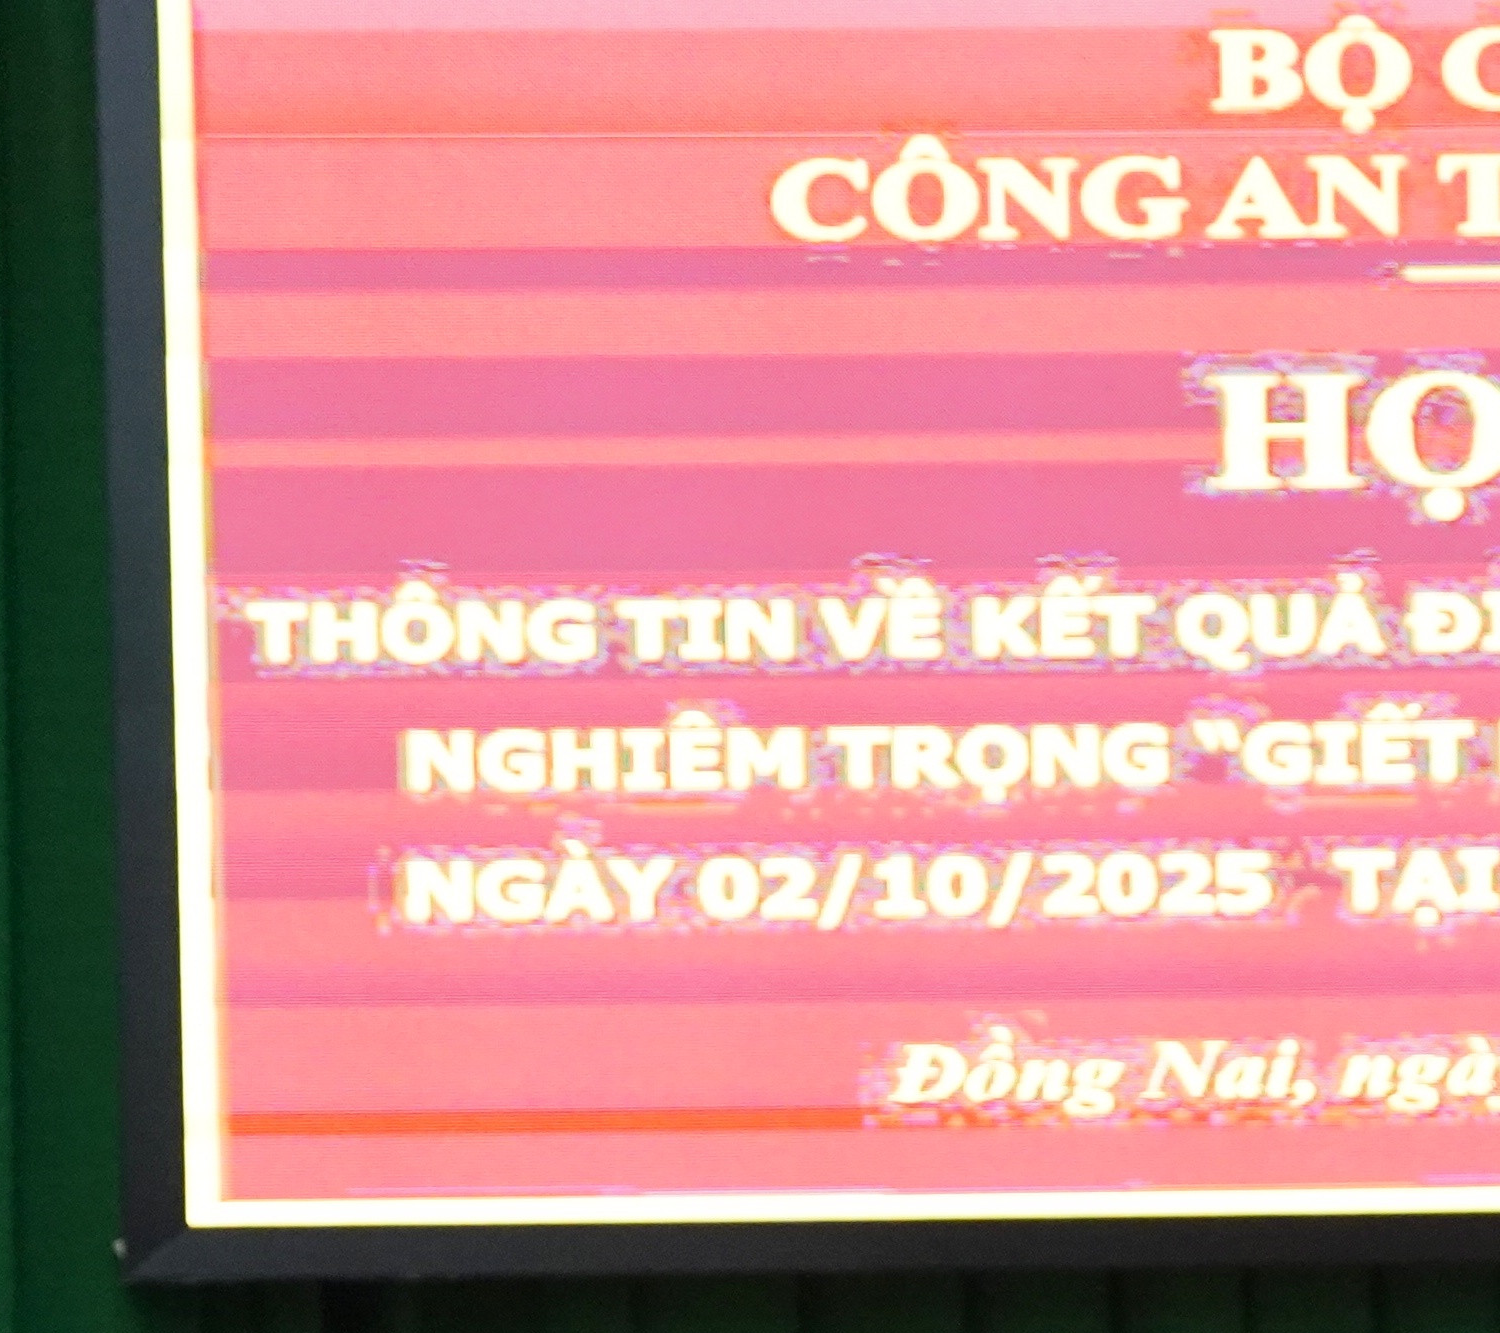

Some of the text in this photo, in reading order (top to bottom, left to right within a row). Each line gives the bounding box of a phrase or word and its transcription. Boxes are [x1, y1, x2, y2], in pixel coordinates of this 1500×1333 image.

[1212, 13, 1411, 130] BỘ
[772, 135, 1186, 240] CÔNG
[1209, 155, 1402, 238] AN
[244, 579, 597, 665] THÔNG
[617, 596, 795, 661] TIN
[819, 575, 942, 660] VỀ
[972, 573, 1156, 659] KẾT
[1175, 570, 1385, 673] QUẢ
[407, 708, 804, 794] NGHIÊM
[827, 721, 1170, 807] TRỌNG
[404, 837, 675, 924] NGÀY
[697, 848, 1272, 931] 02/10/2025
[889, 1024, 1127, 1115] Đồng
[1142, 1037, 1316, 1107] Nai,
